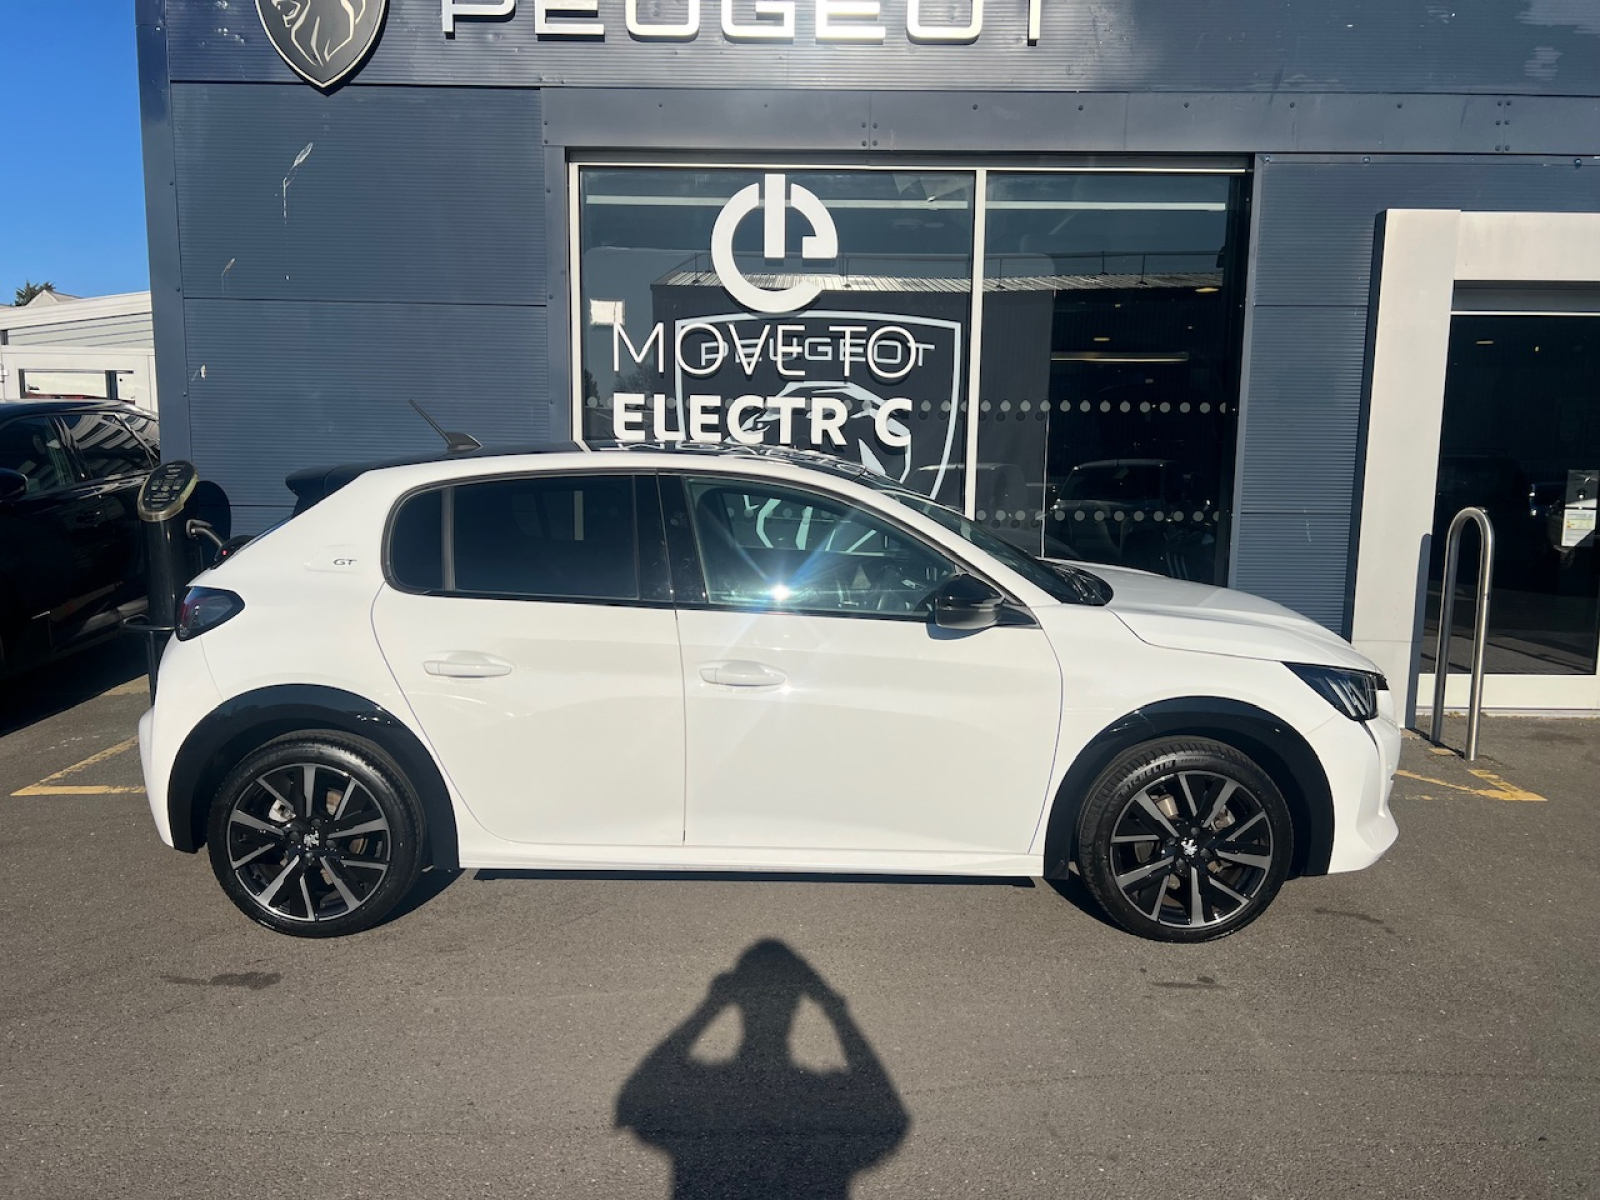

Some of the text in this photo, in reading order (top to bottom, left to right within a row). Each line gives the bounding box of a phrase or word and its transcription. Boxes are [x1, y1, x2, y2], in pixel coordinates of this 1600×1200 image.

[612, 321, 917, 379] MOVE TO
[700, 336, 936, 367] PEUGEOT
[333, 558, 358, 566] GT
